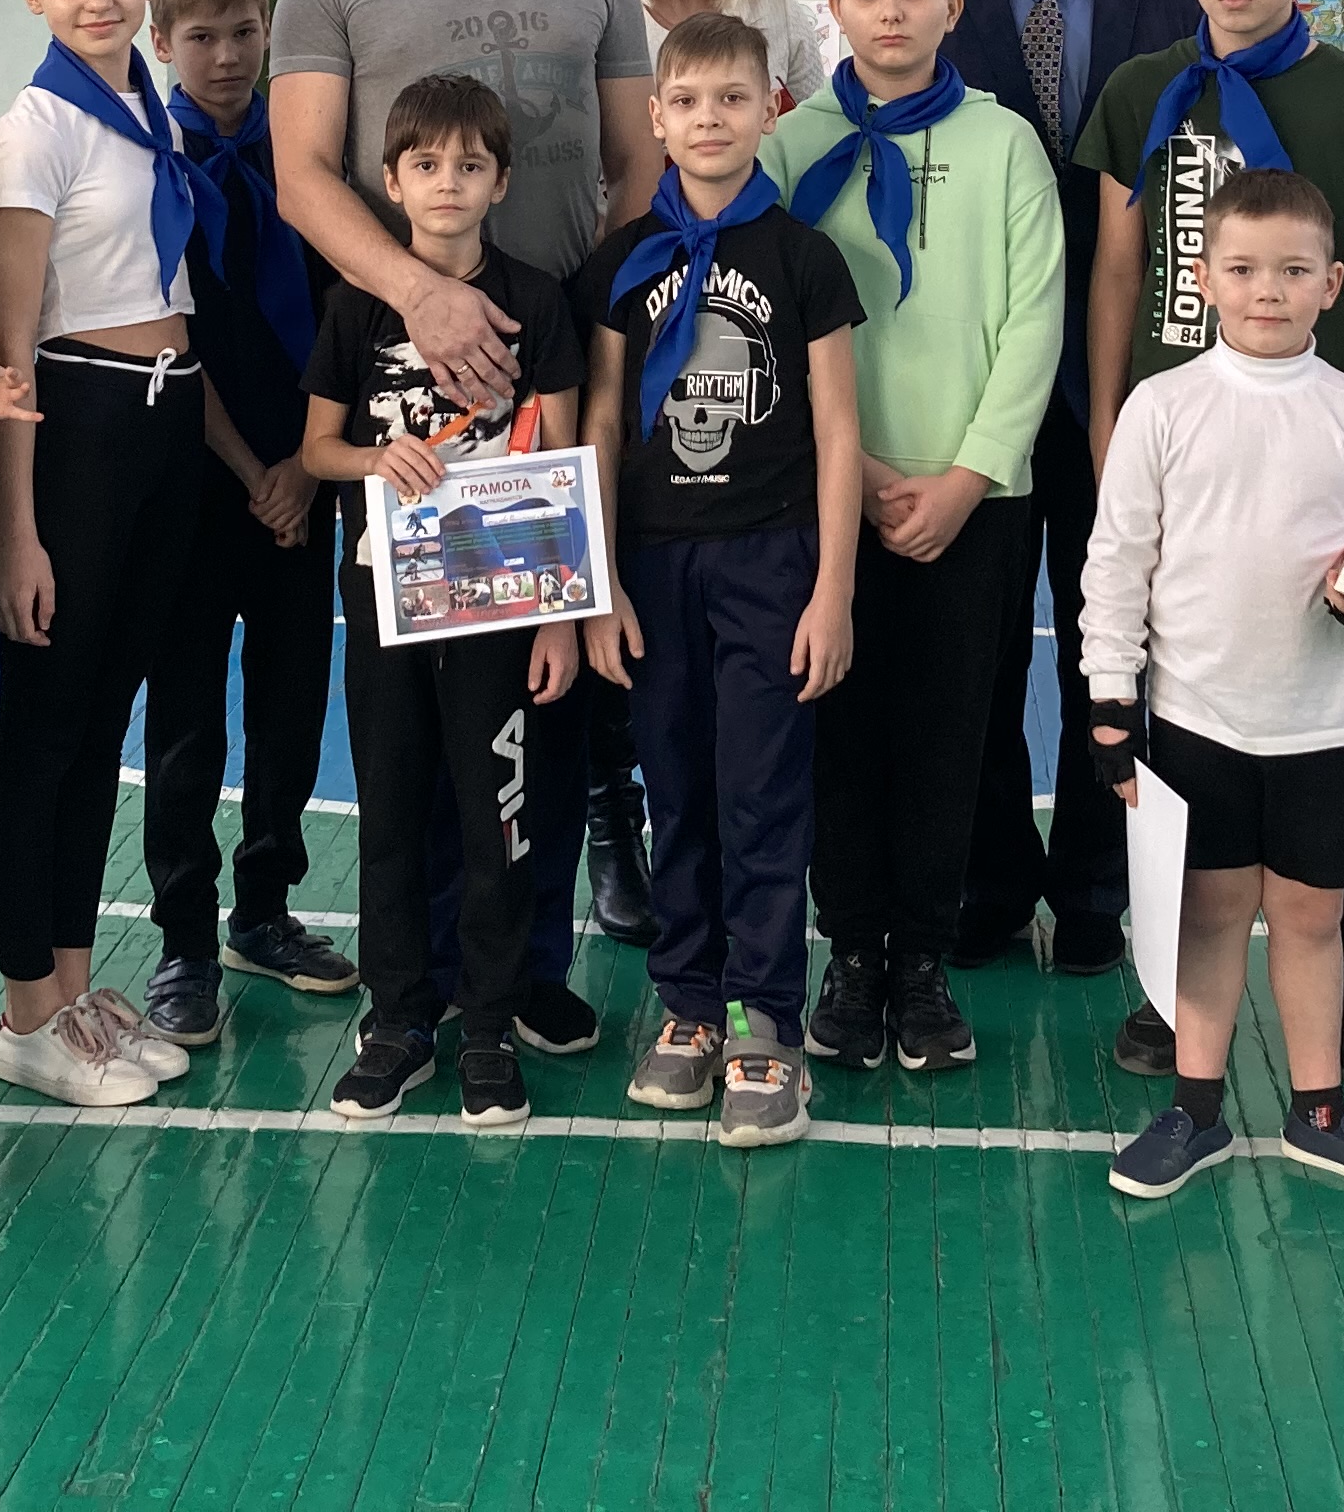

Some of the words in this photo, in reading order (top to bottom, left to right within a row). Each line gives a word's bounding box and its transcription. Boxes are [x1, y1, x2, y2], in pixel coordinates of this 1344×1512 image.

[1173, 145, 1205, 319] ORIGINAL
[1179, 327, 1202, 345] 84
[686, 374, 743, 398] RHYTHM
[551, 469, 567, 482] 23
[460, 477, 532, 499] ГРАМОТА
[491, 708, 531, 867] FILA
